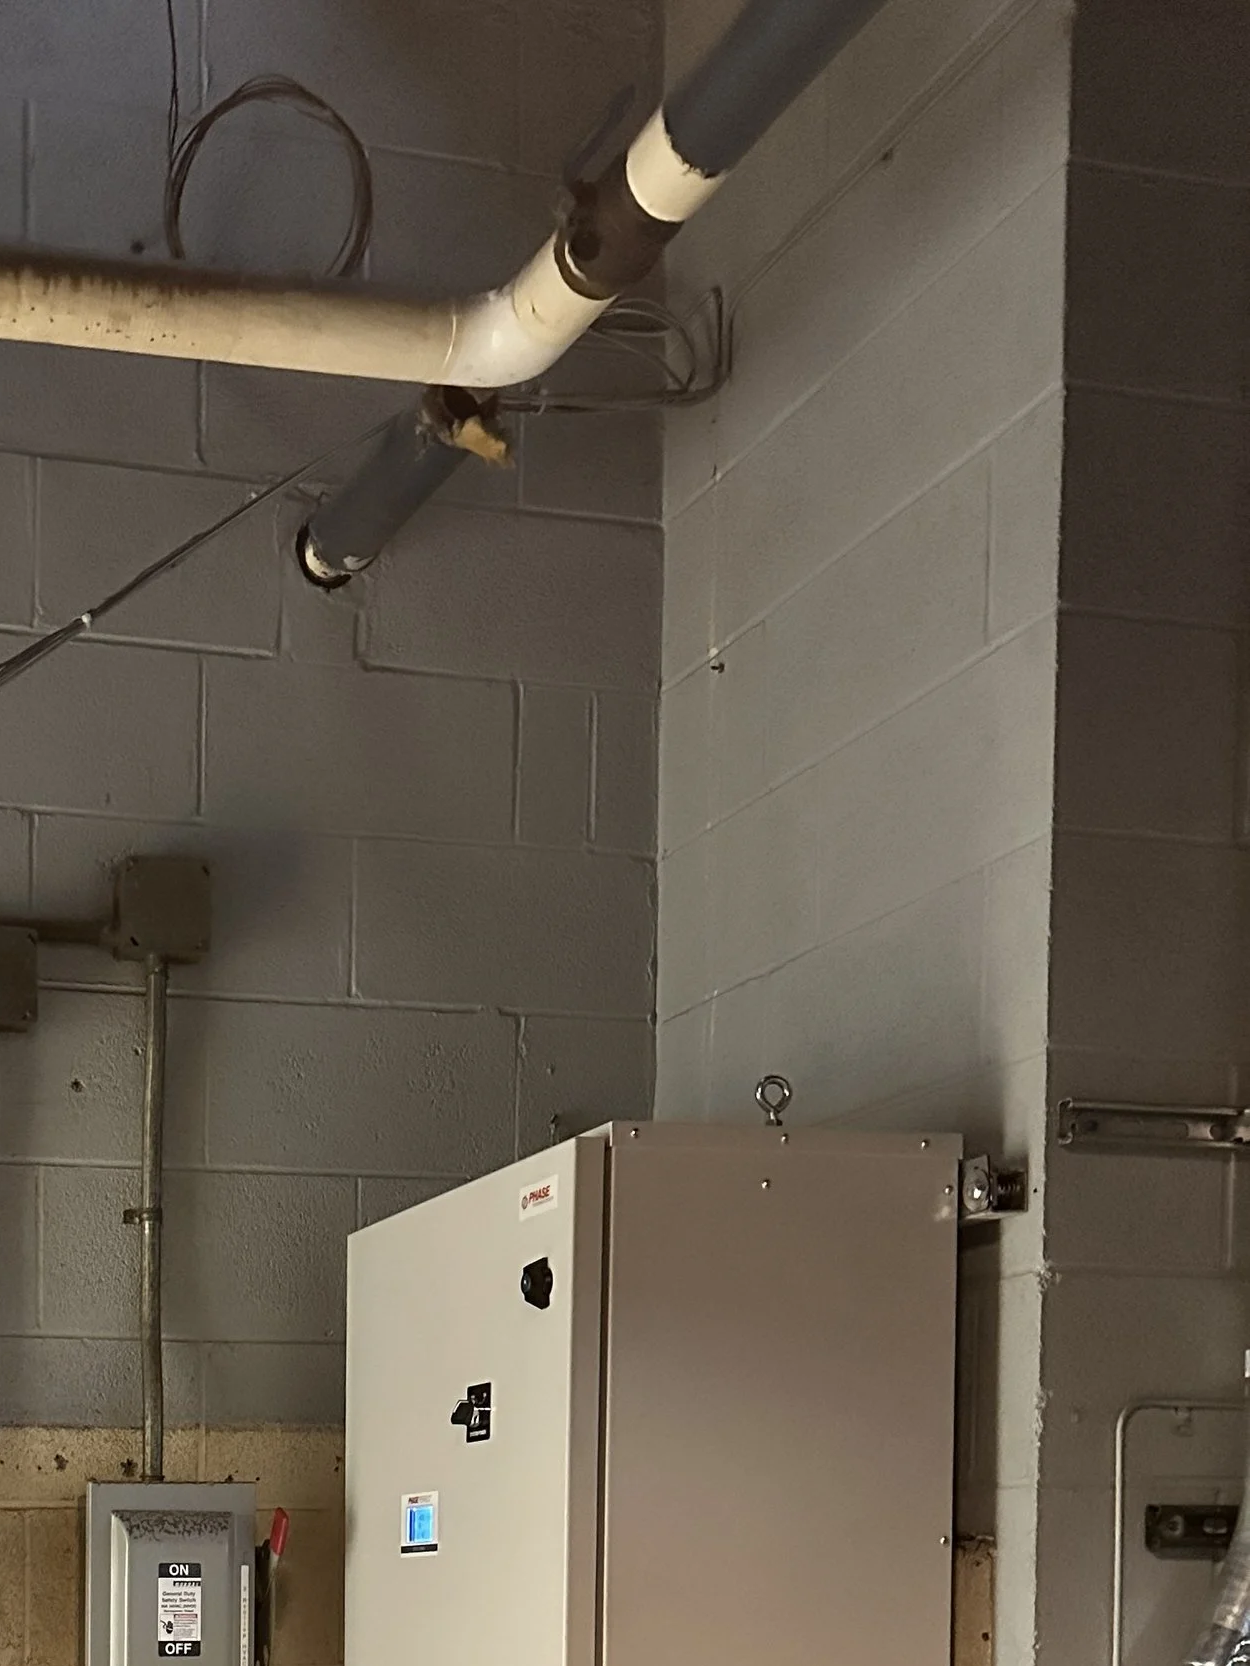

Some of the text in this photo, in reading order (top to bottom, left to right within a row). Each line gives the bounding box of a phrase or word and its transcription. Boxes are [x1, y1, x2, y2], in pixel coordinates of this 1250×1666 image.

[528, 1185, 551, 1203] PHASE
[168, 1564, 189, 1576] ON
[165, 1642, 192, 1655] OFF
